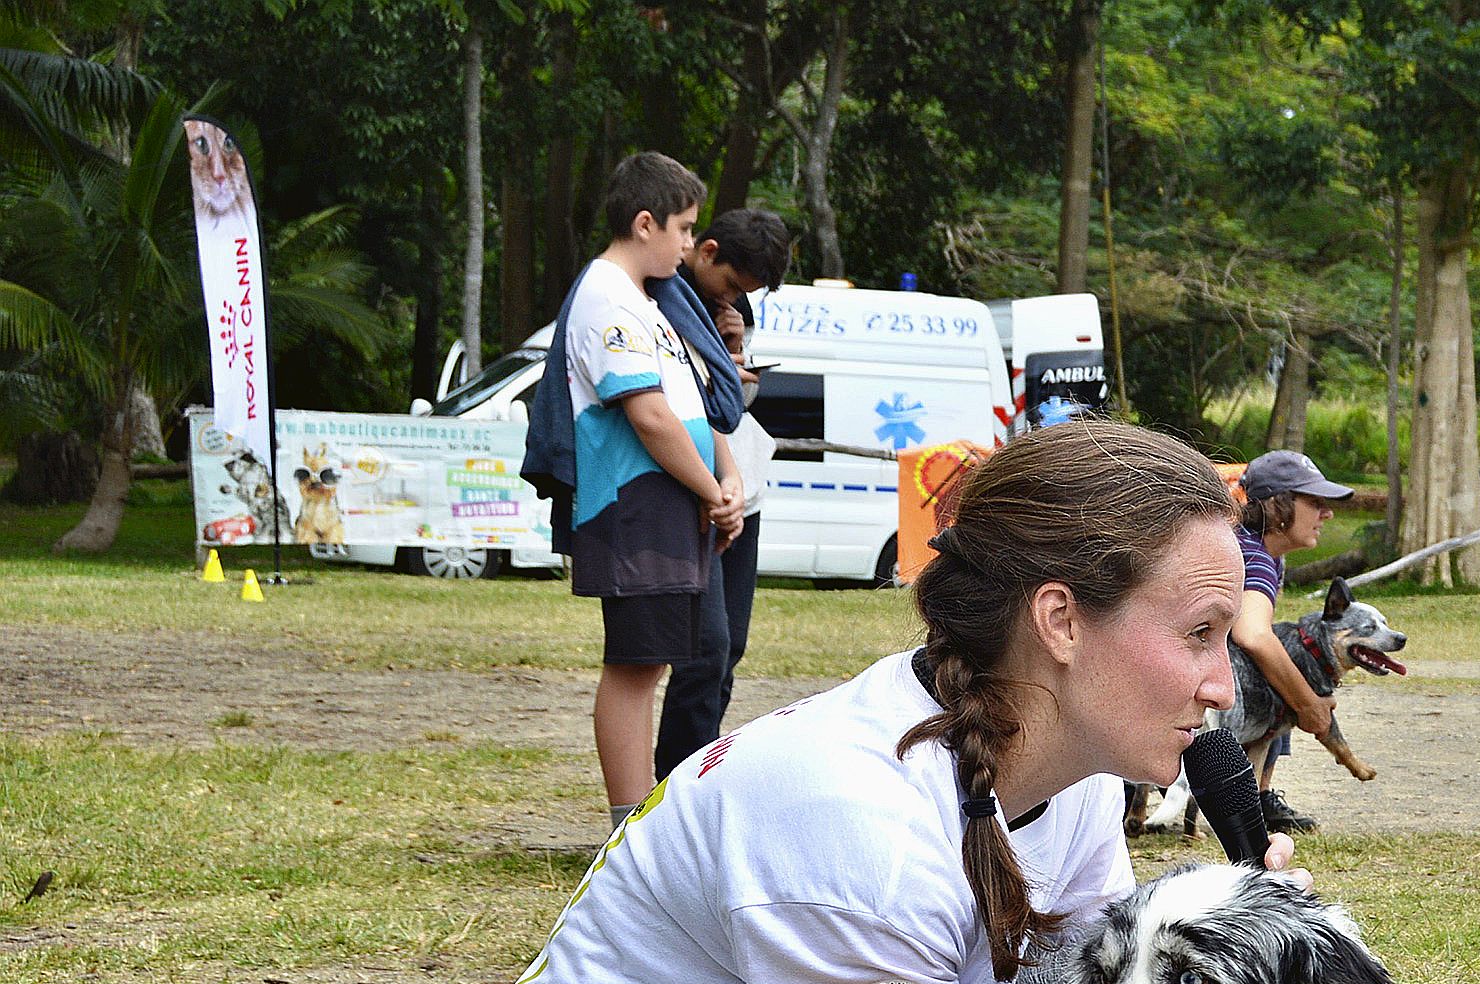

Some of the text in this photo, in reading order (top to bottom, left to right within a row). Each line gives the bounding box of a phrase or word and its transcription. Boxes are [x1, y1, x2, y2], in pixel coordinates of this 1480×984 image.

[235, 238, 256, 420] ROYAL CANIN
[888, 312, 977, 337] 25 33 99
[1041, 366, 1106, 384] AMBUL
